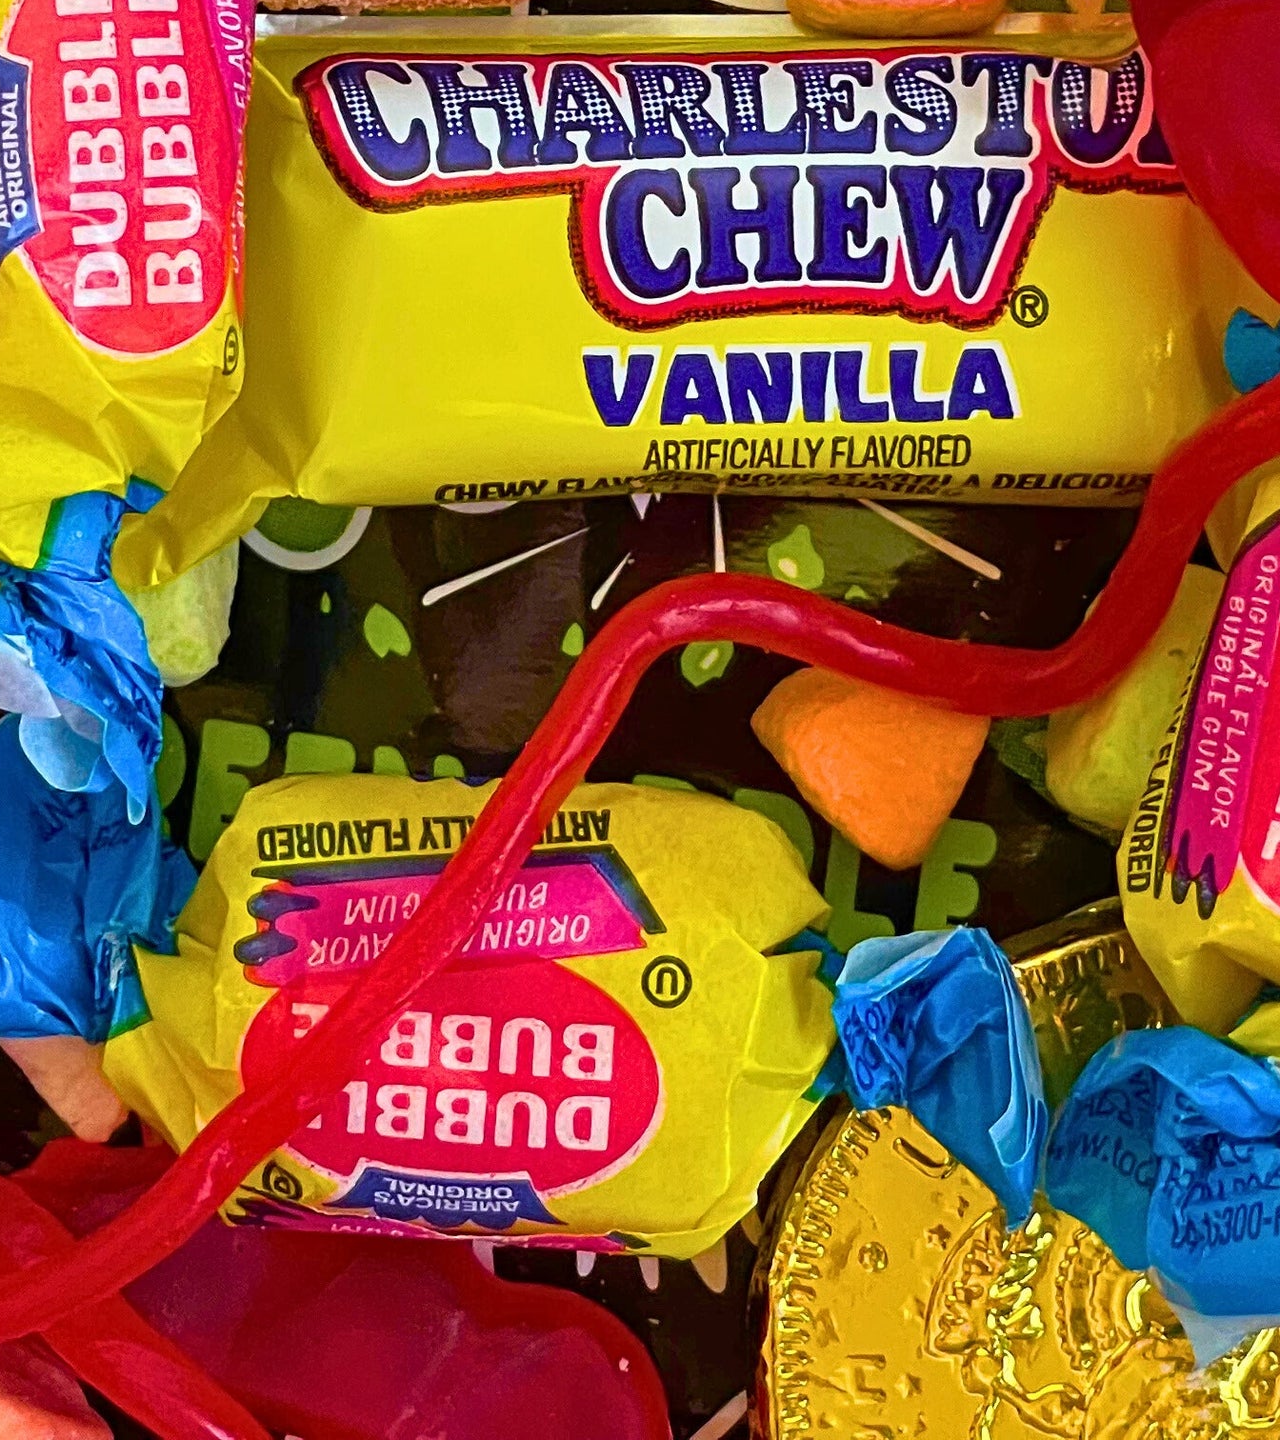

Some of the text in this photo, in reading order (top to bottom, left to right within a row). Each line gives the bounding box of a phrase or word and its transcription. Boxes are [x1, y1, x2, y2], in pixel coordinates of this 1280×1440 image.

[0, 83, 29, 220] ORIGINAL
[332, 53, 1176, 181] CHARLESTO
[606, 163, 1025, 301] CHEW
[582, 346, 1017, 426] VANILLA
[643, 434, 972, 472] ARTIFICIALLY FLAVORED
[435, 479, 548, 503] CHEWY
[1190, 595, 1246, 792] BUBBLE GUM
[1210, 553, 1280, 828] ORIGINAL FLAVOR
[256, 817, 411, 861] FLAVORED
[307, 915, 591, 968] ORIGIN AVOR
[306, 1082, 612, 1152] DUBBL
[375, 1190, 519, 1213] AMERICA'S
[383, 1176, 513, 1201] ORIGINAL
